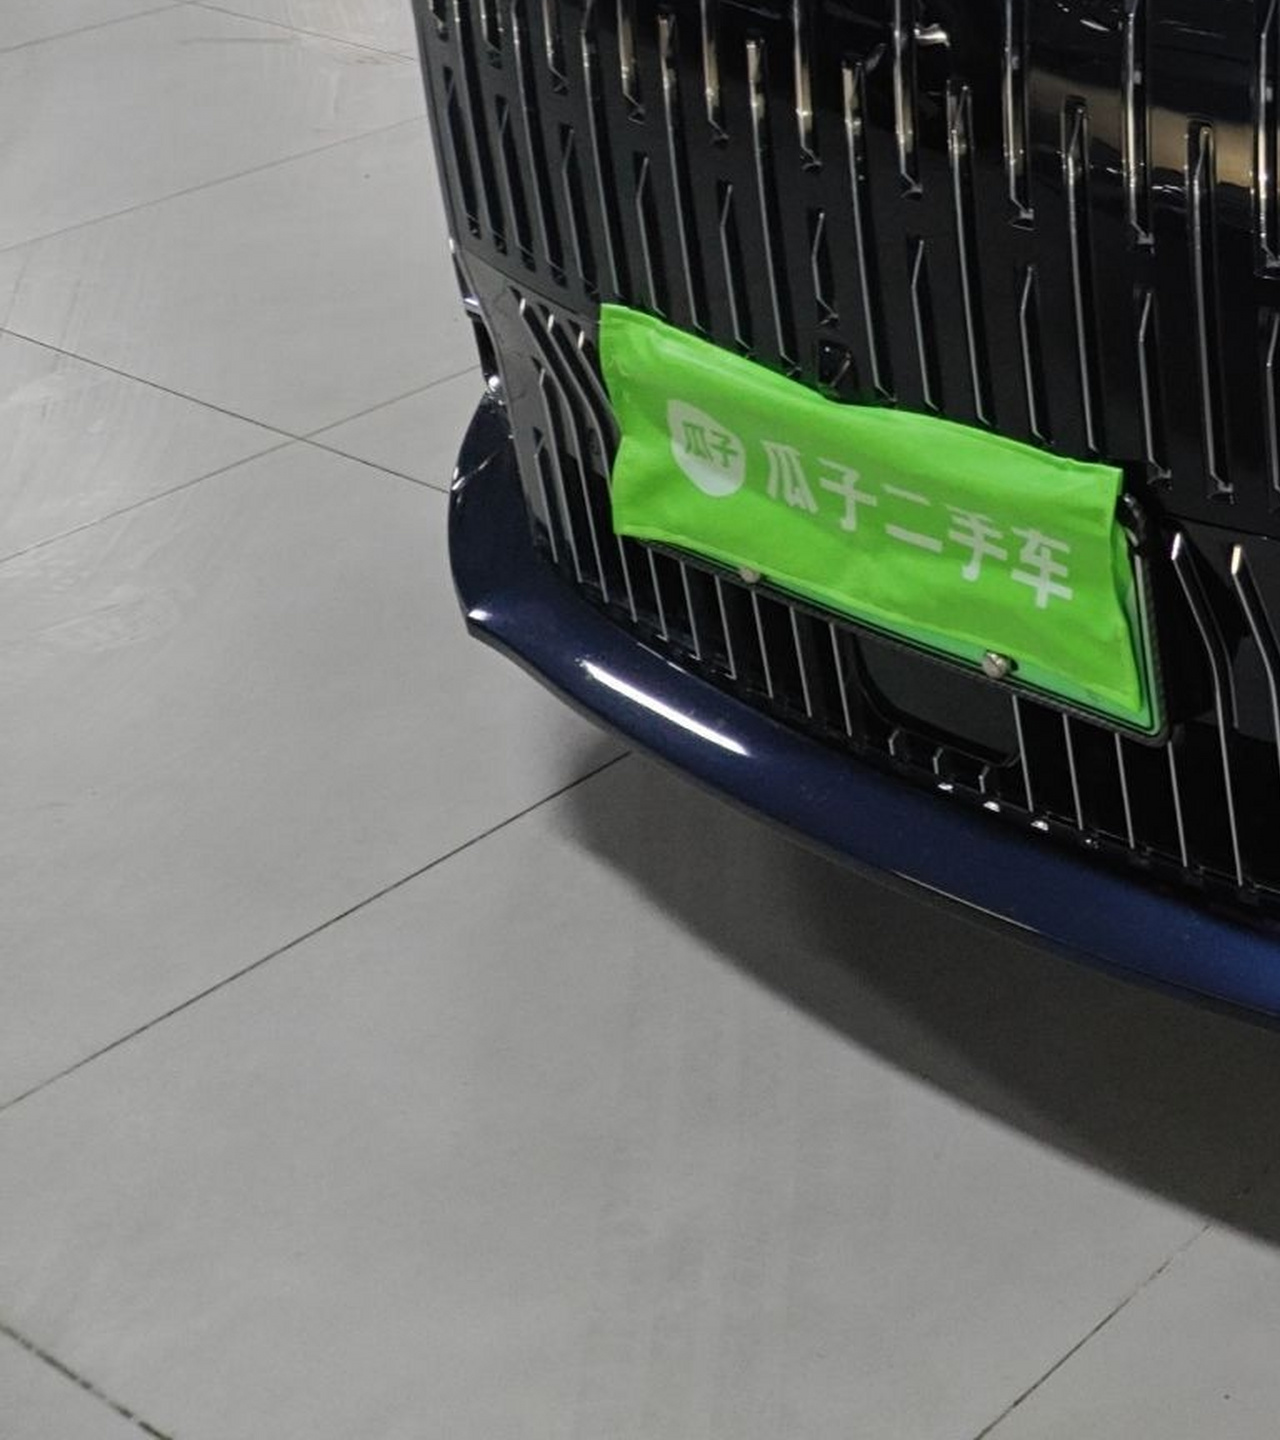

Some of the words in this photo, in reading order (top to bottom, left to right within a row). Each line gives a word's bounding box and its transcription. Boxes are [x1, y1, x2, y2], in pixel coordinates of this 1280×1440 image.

[681, 420, 738, 469] 瓜子
[762, 439, 1074, 609] 瓜子二手车
